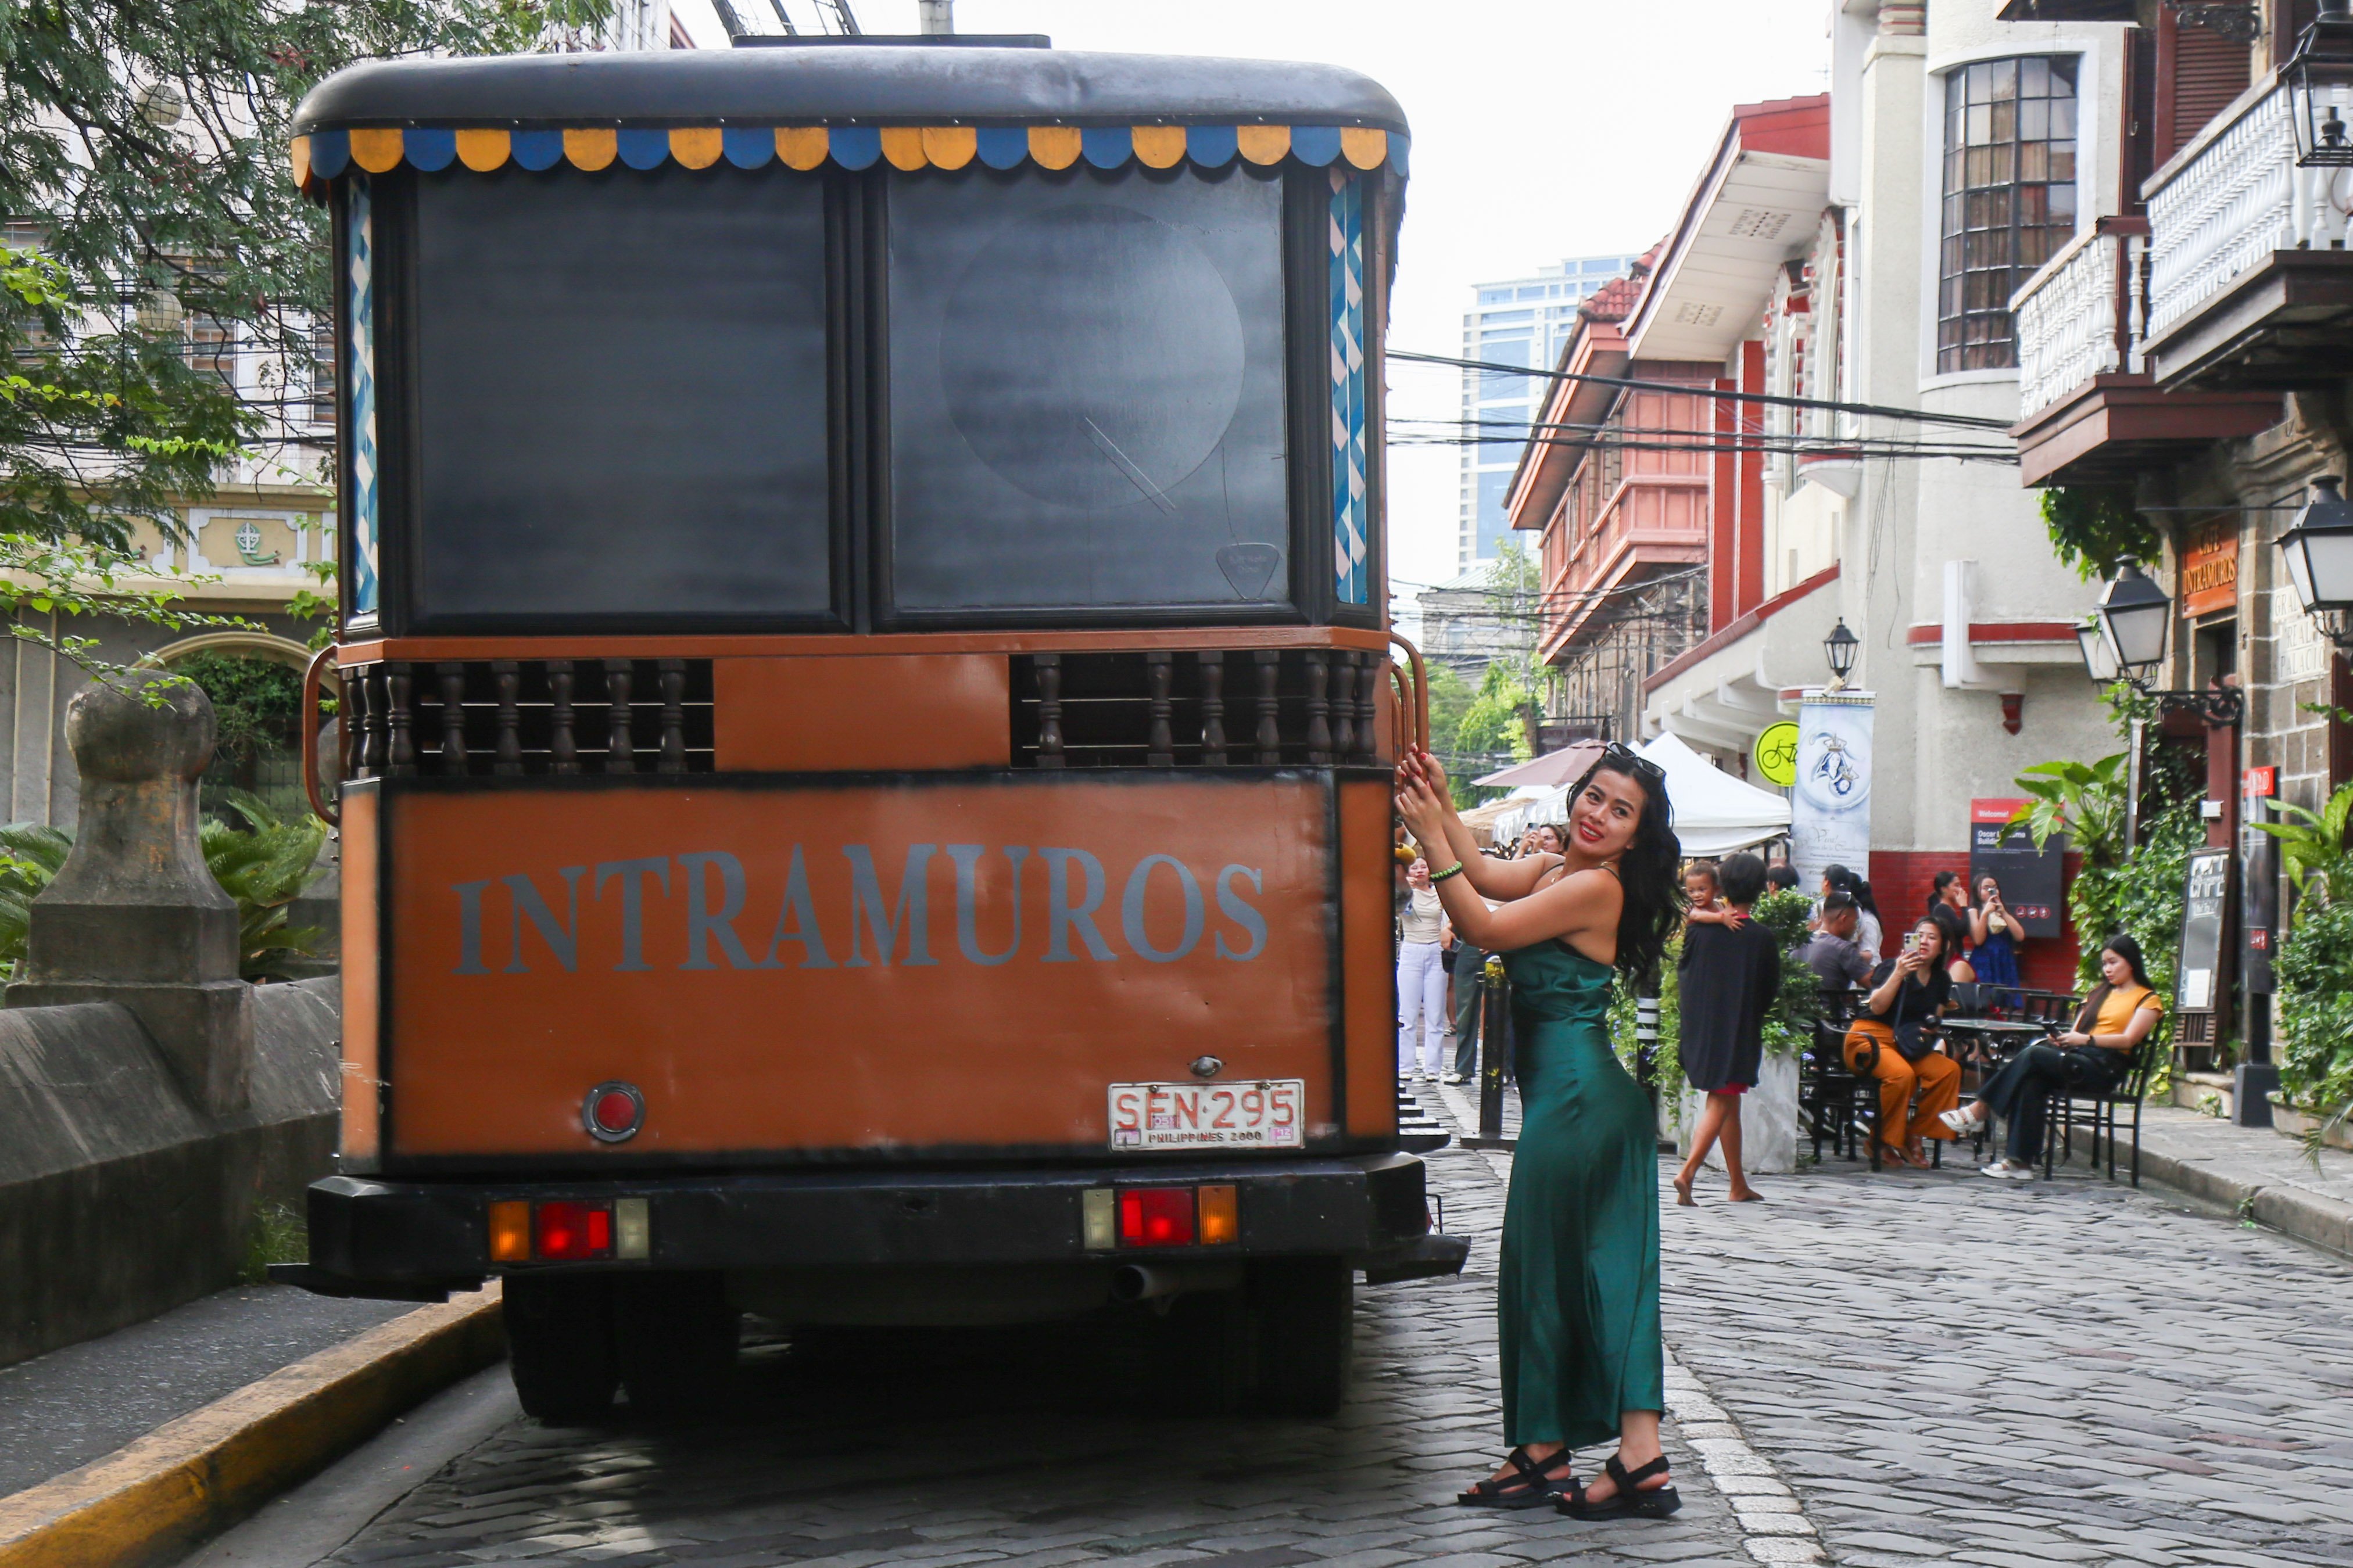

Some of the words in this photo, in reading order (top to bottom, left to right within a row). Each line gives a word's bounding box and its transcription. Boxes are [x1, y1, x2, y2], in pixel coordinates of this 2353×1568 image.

[2183, 556, 2236, 595] INTRAMUROS
[2280, 645, 2324, 677] PALACIO
[1978, 810, 2009, 818] Welcome!
[450, 842, 1268, 975] INTRAMUROS
[1148, 1132, 1224, 1143] PHILIPPINES
[1230, 1131, 1262, 1142] 2000
